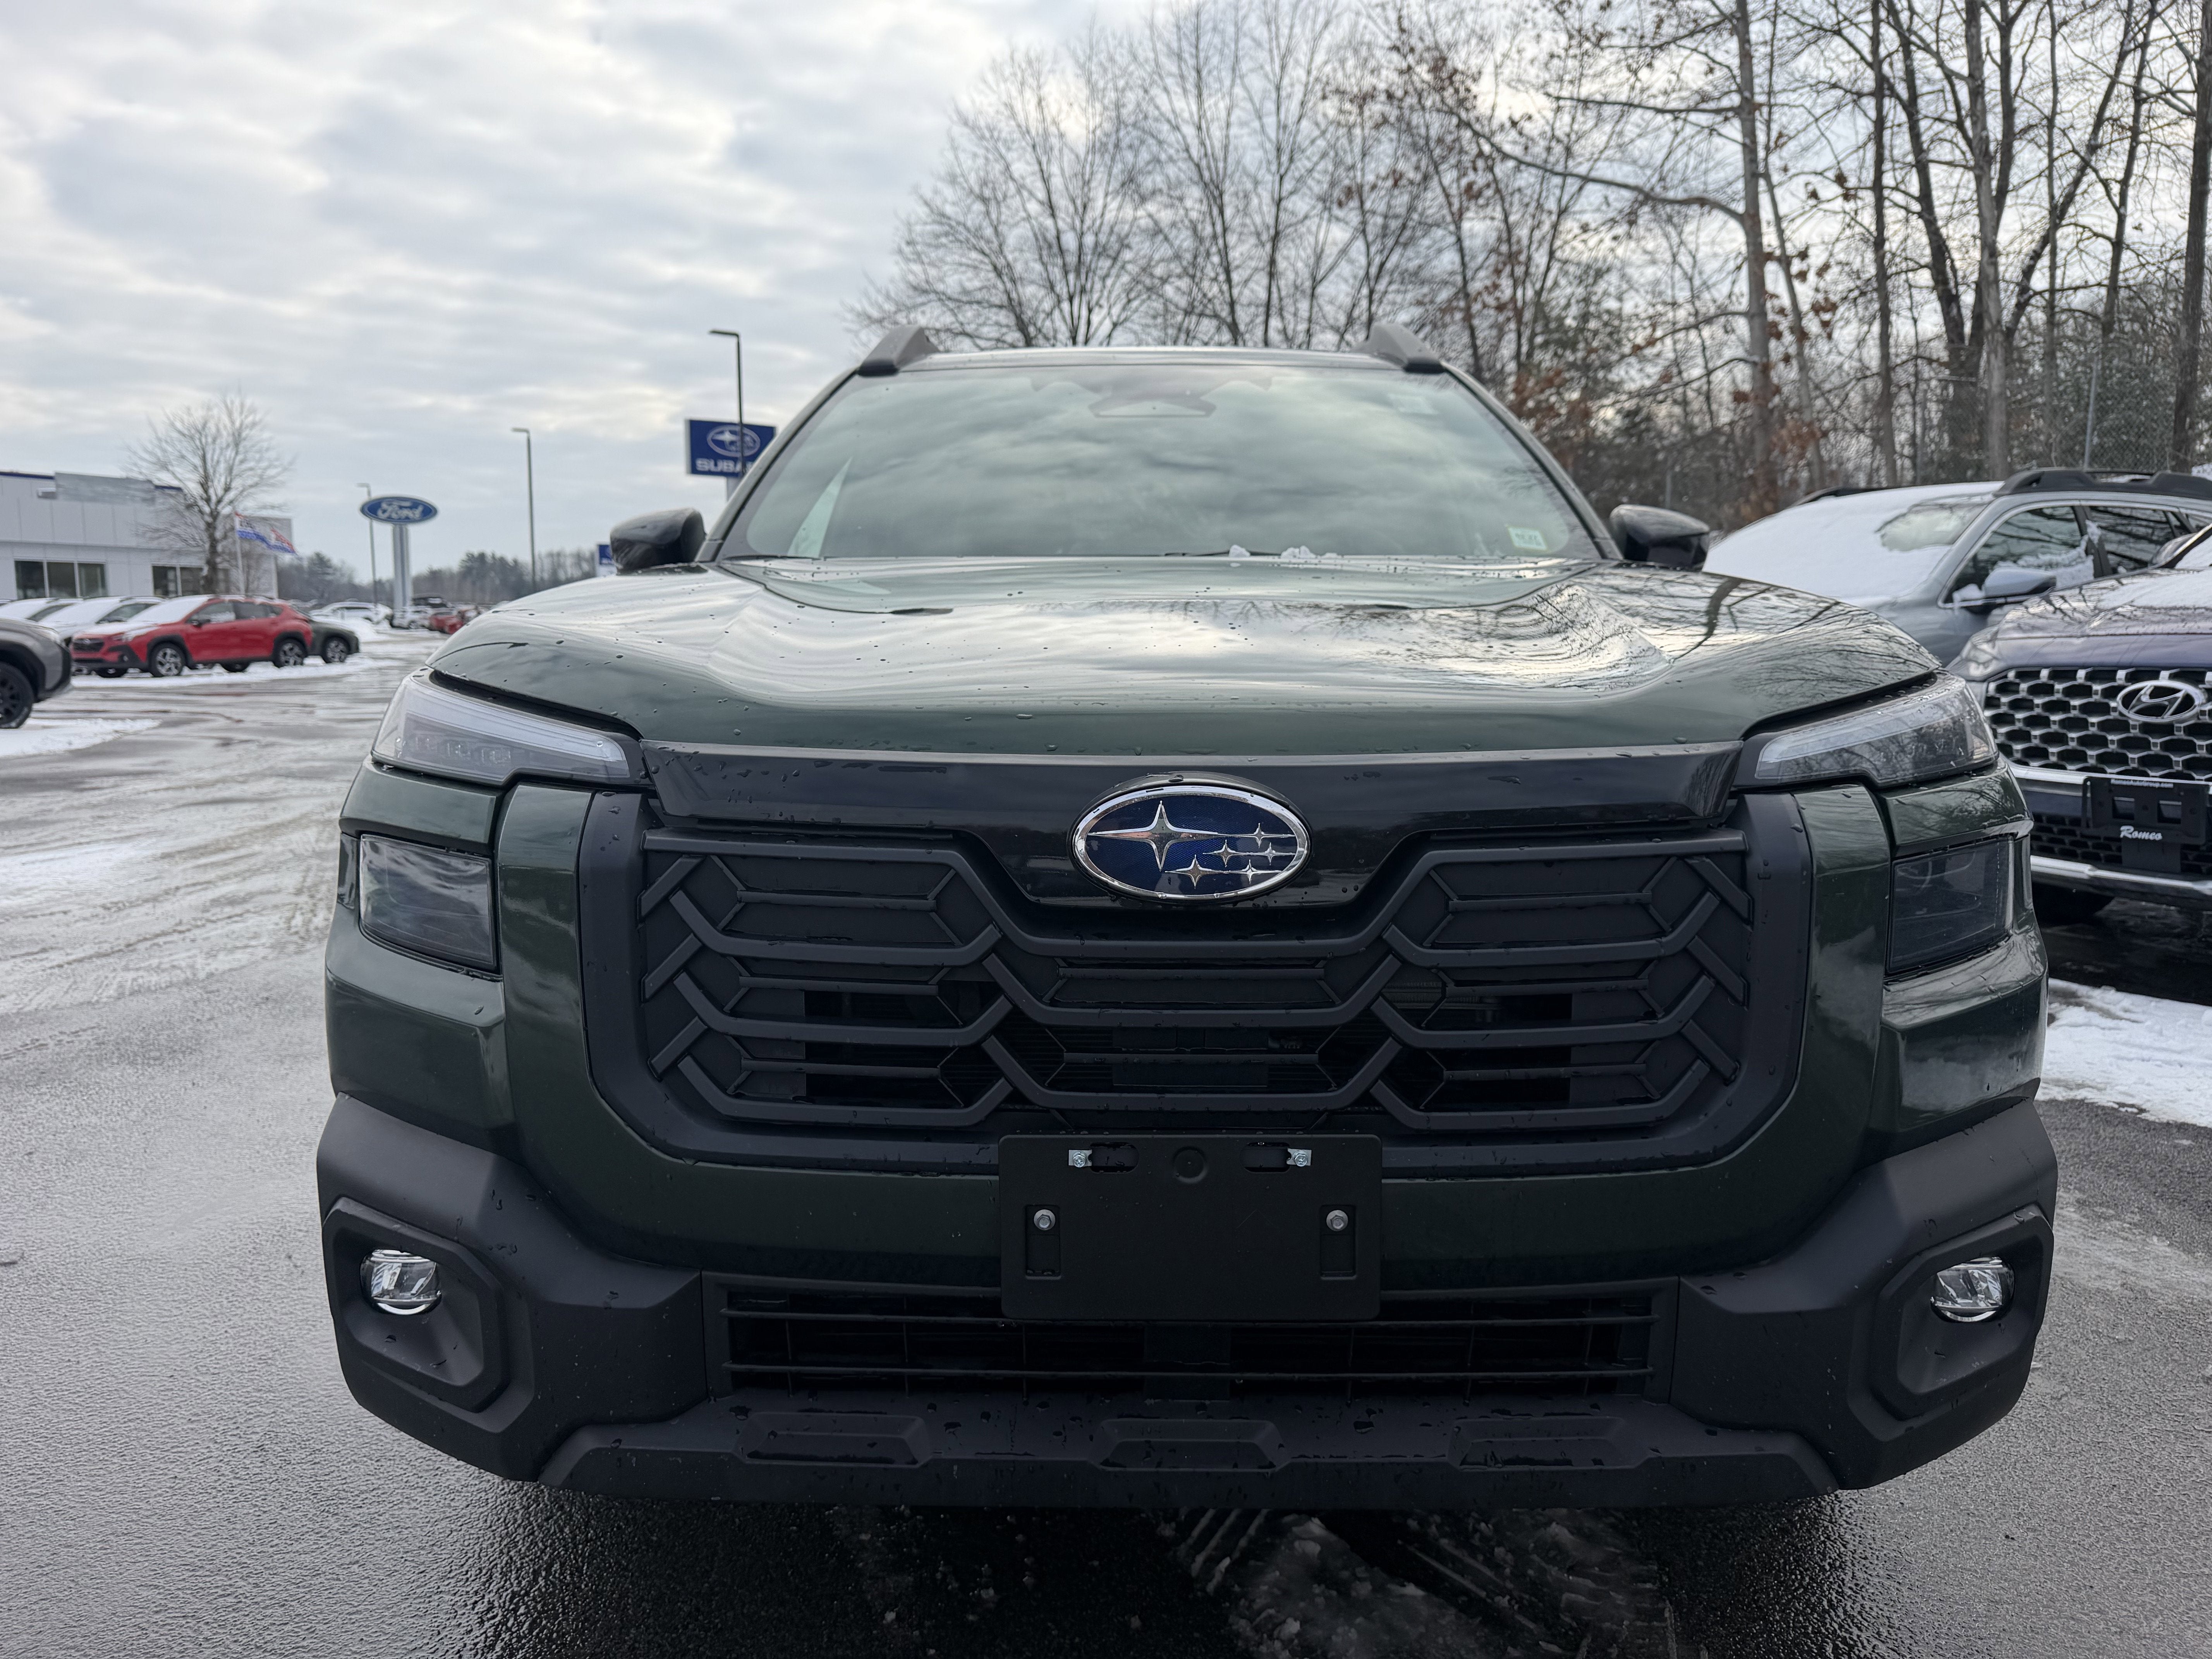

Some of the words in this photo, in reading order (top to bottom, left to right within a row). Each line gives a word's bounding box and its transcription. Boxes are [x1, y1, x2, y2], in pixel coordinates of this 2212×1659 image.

[696, 458, 755, 473] SUBA
[377, 501, 424, 519] Ford
[2120, 825, 2162, 841] Romeo
